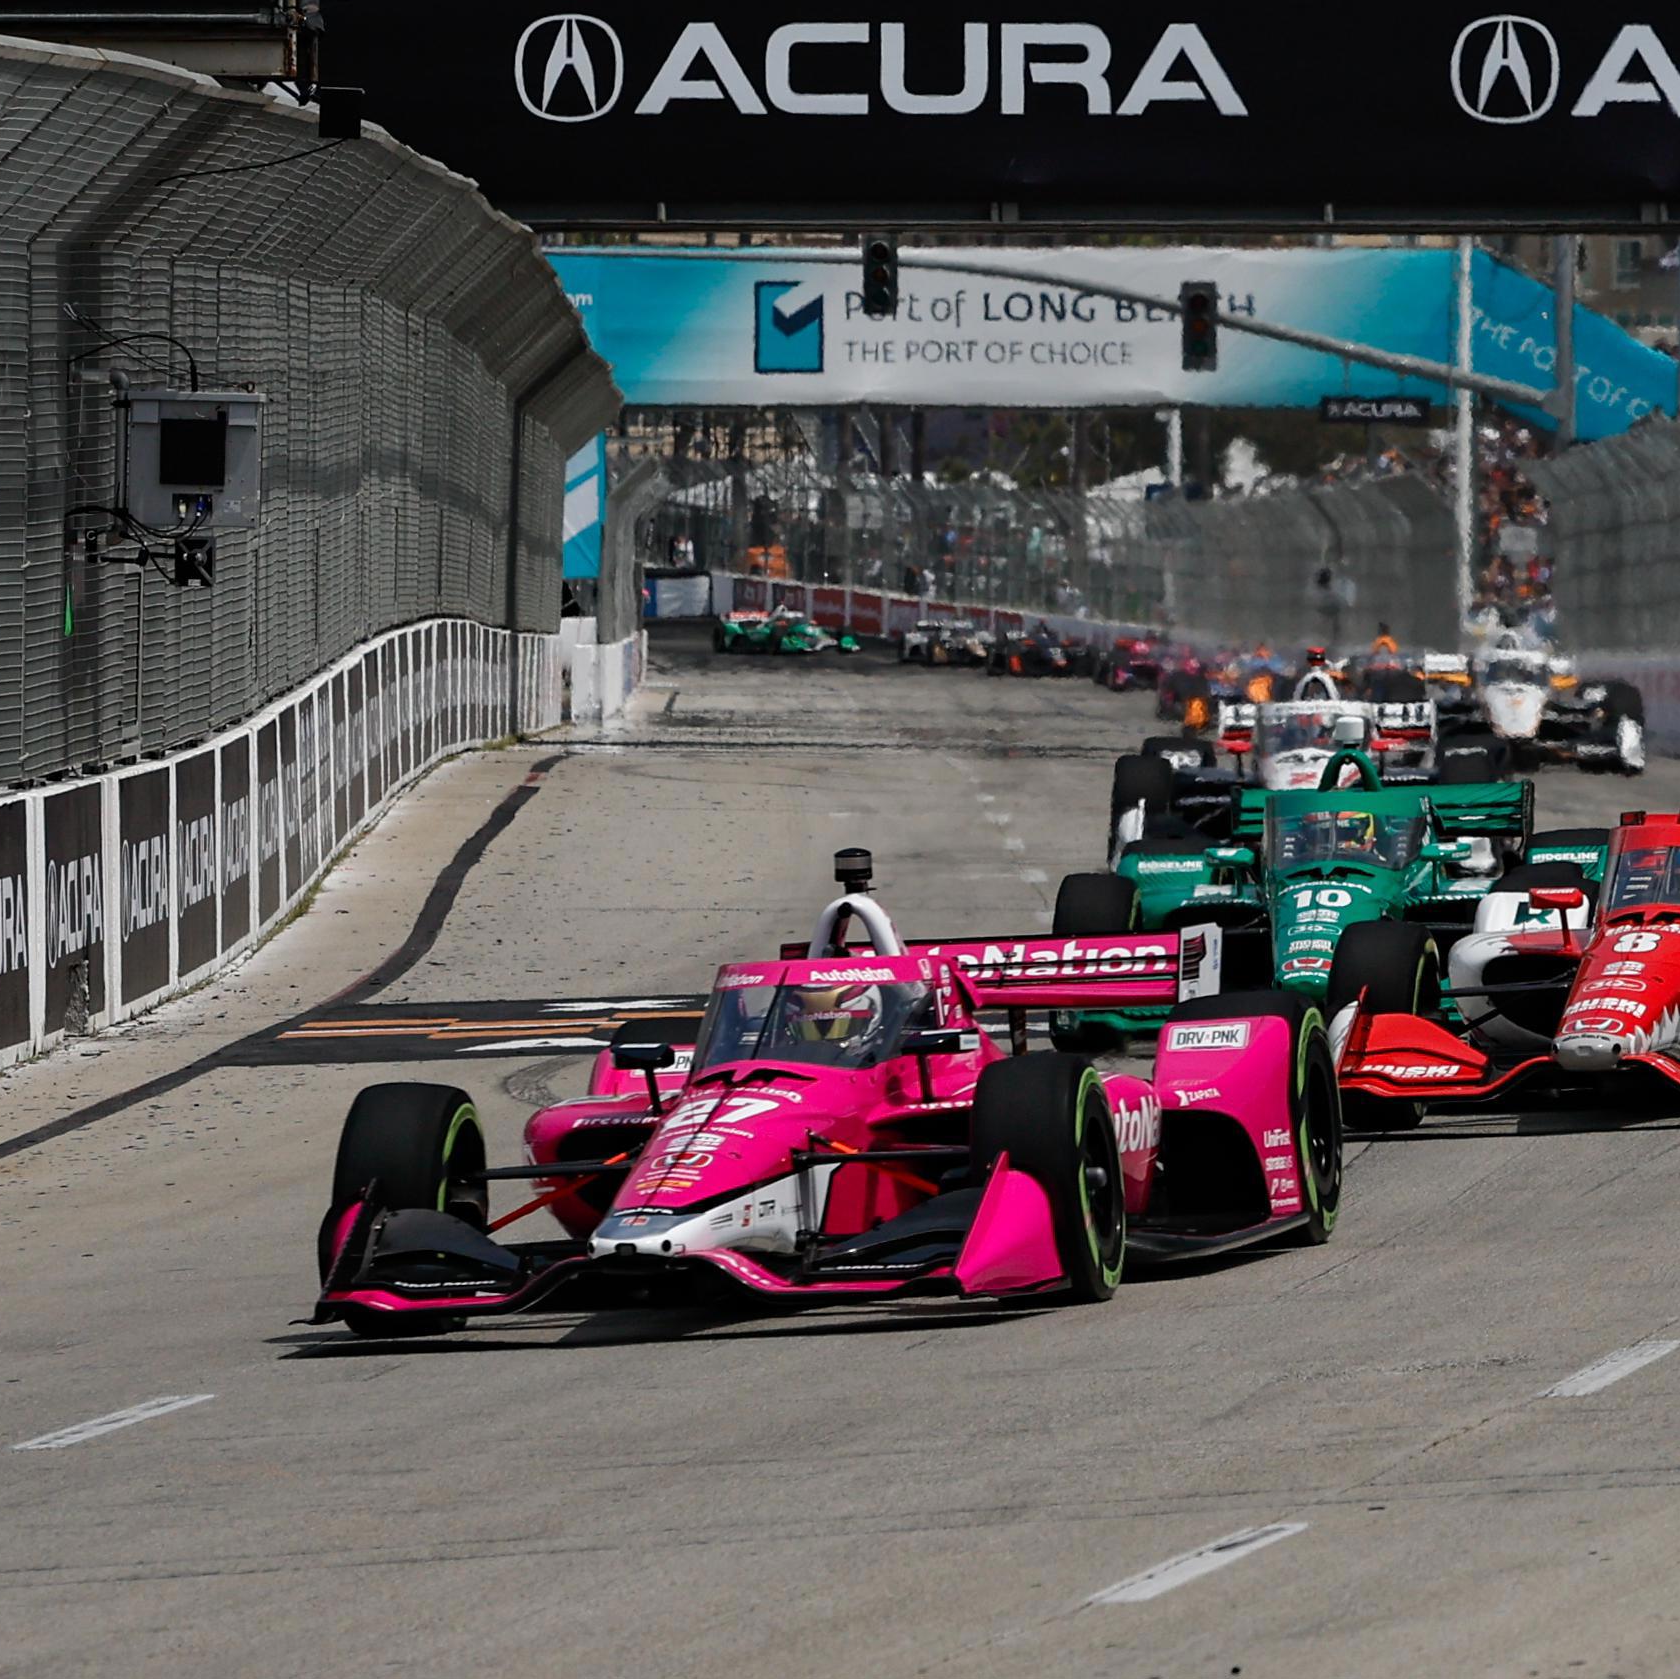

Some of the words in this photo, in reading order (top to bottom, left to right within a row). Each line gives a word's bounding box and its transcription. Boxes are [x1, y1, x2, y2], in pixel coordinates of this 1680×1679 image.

[634, 22, 1249, 117] ACURA
[931, 290, 966, 328] of
[984, 291, 1097, 322] LONG
[844, 340, 896, 364] THE
[906, 340, 979, 365] PORT
[985, 340, 1023, 365] OF
[1030, 341, 1133, 366] CHOICE
[1520, 336, 1593, 385] POT
[1344, 400, 1421, 419] ACURA
[183, 813, 216, 919] ACURA
[129, 833, 169, 932] ACURA
[58, 852, 104, 958] ACURA
[1293, 888, 1352, 909] 10
[1613, 931, 1662, 953] 8
[810, 967, 896, 983] AutoNation
[1176, 1031, 1207, 1046] DRV
[1211, 1028, 1240, 1044] PNK
[1360, 1064, 1461, 1079] HUSKI
[1189, 1087, 1221, 1102] ZAPATA
[659, 1096, 781, 1134] 27
